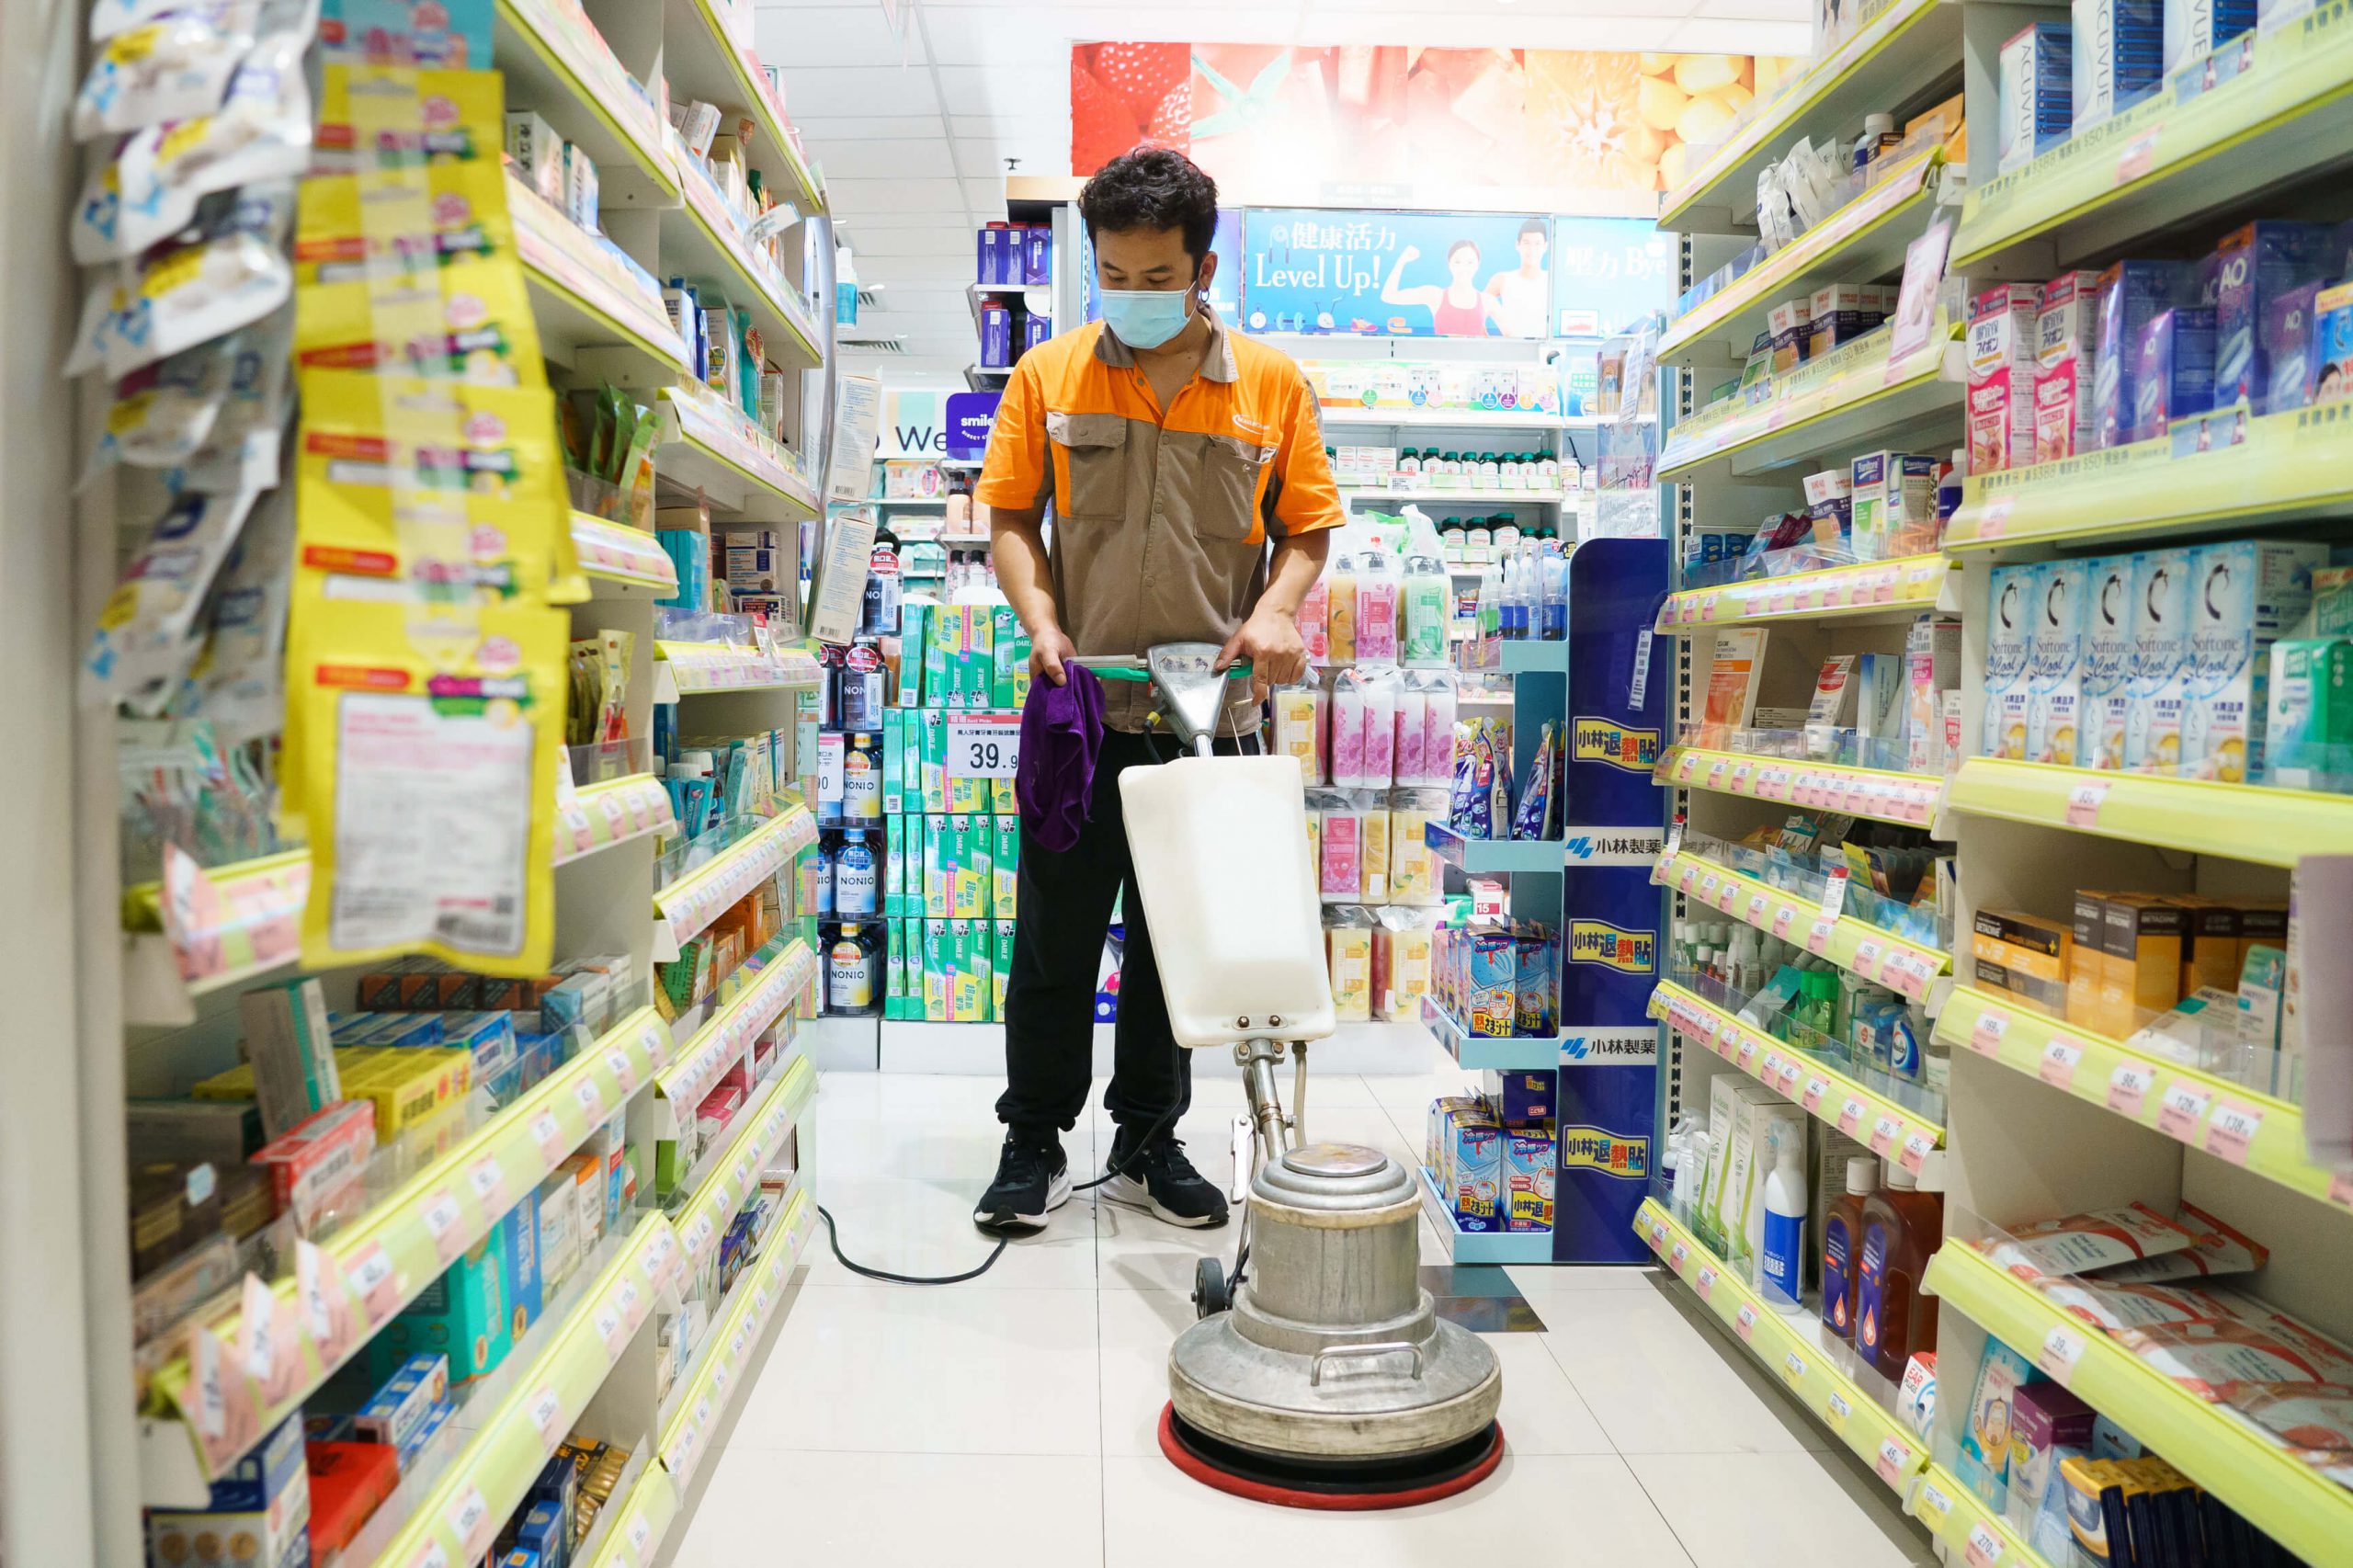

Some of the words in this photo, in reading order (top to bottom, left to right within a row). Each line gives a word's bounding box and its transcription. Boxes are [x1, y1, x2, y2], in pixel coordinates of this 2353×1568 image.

[2019, 44, 2031, 148] ACUVUE
[1291, 222, 1396, 250] 健康活力
[1255, 253, 1325, 288] Level
[1334, 254, 1381, 296] Up!
[2221, 257, 2246, 290] AO
[961, 415, 995, 426] smile
[895, 426, 947, 451] We
[961, 430, 981, 440] DIRECT
[865, 591, 882, 600] NO
[1993, 656, 2017, 676] Cool
[2039, 656, 2063, 676] Cool
[2094, 654, 2120, 676] Cool
[2136, 653, 2167, 676] Cool
[2195, 652, 2228, 676] Cool
[971, 743, 1018, 769] 39.9
[1577, 729, 1655, 764] 小林退熱貼
[843, 781, 874, 790] NONIO
[840, 877, 874, 885] NONIO
[1477, 903, 1490, 914] 15
[1976, 921, 2001, 937] BETADINE
[1574, 931, 1651, 965] 小林退熱貼
[831, 971, 865, 979] NONIO
[1567, 1138, 1644, 1171] 小林退熱貼
[1904, 1379, 1918, 1393] PLUGS
[1907, 1367, 1924, 1386] EAR
